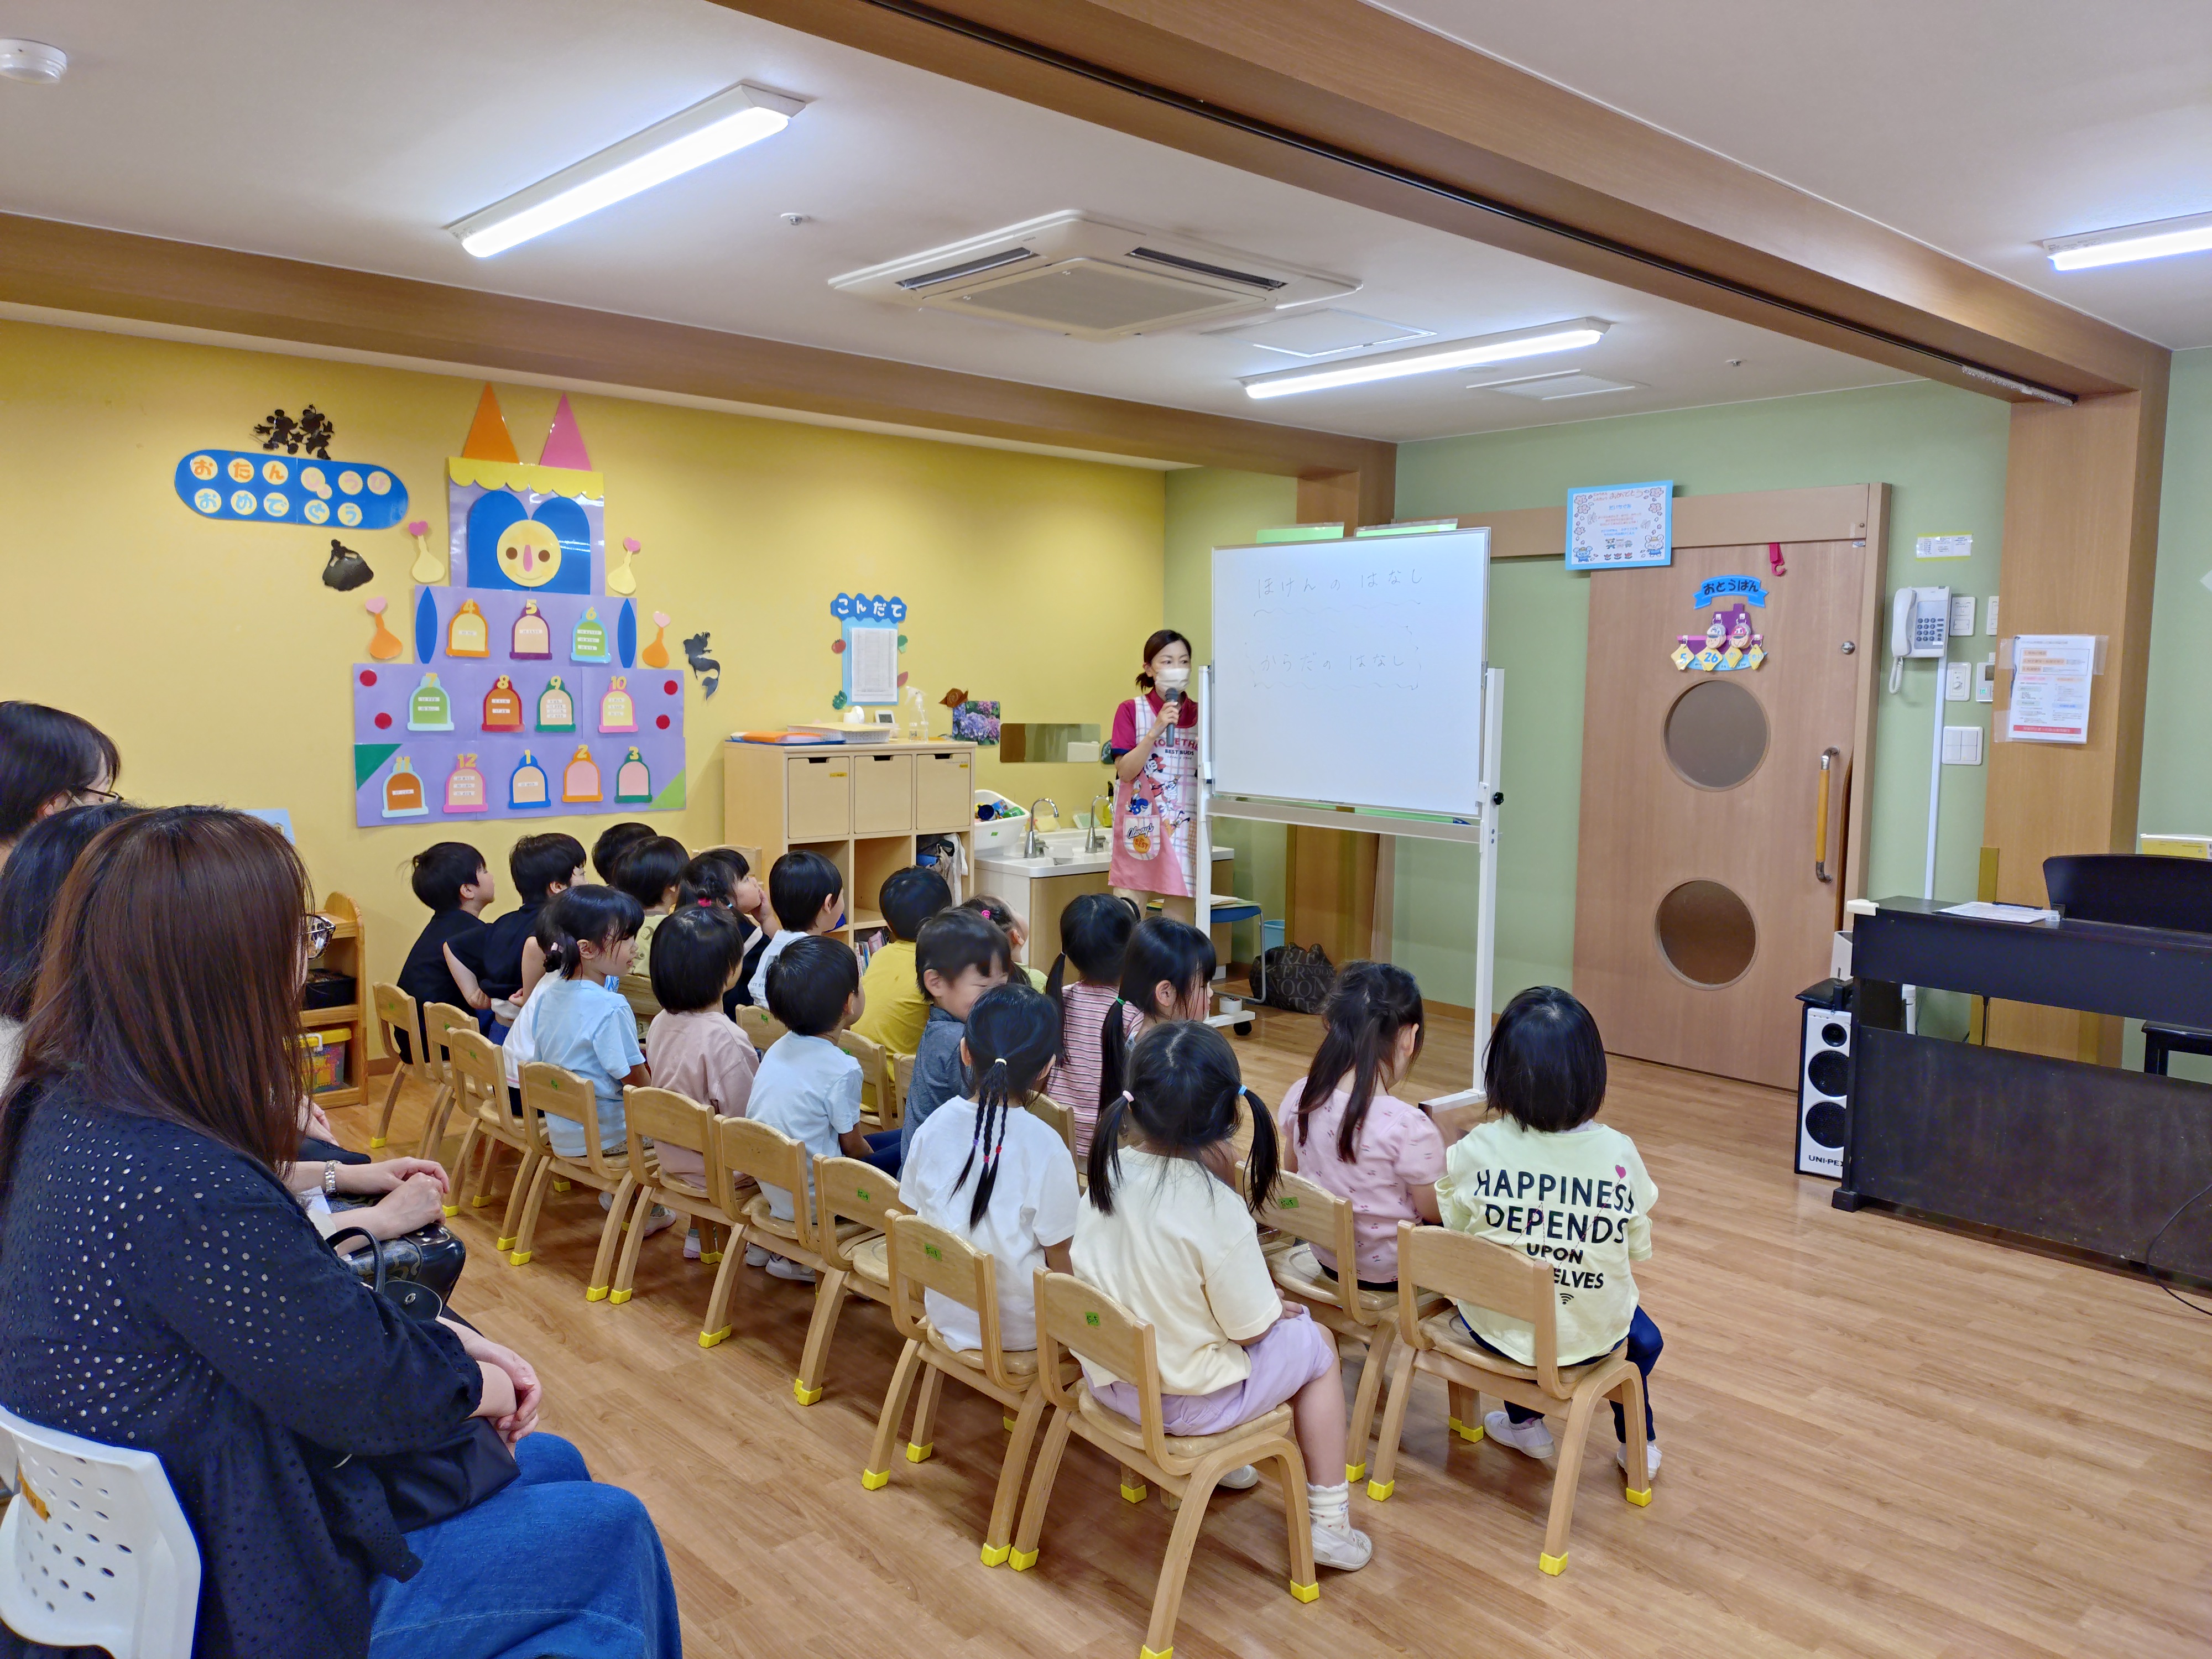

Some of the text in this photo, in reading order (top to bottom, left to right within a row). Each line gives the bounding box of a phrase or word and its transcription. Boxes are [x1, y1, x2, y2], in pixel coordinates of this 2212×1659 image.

[197, 493, 357, 521] おめでとう
[1703, 579, 1759, 595] おとうばん
[463, 599, 474, 614] 4
[526, 599, 537, 614] 5
[586, 607, 597, 620] 6
[838, 598, 902, 617] こんだて
[1704, 653, 1718, 663] 26
[426, 672, 437, 687] 7
[497, 675, 509, 689] 8
[551, 676, 561, 690] 9
[611, 676, 627, 690] 10
[525, 749, 531, 764] 1
[577, 744, 588, 758] 2
[629, 746, 639, 760] 3
[396, 757, 410, 771] 11
[457, 753, 477, 768] 12
[1474, 1169, 1634, 1214] HAPPINESS
[1485, 1204, 1629, 1244] DEPENDS
[1527, 1243, 1583, 1265] UPON
